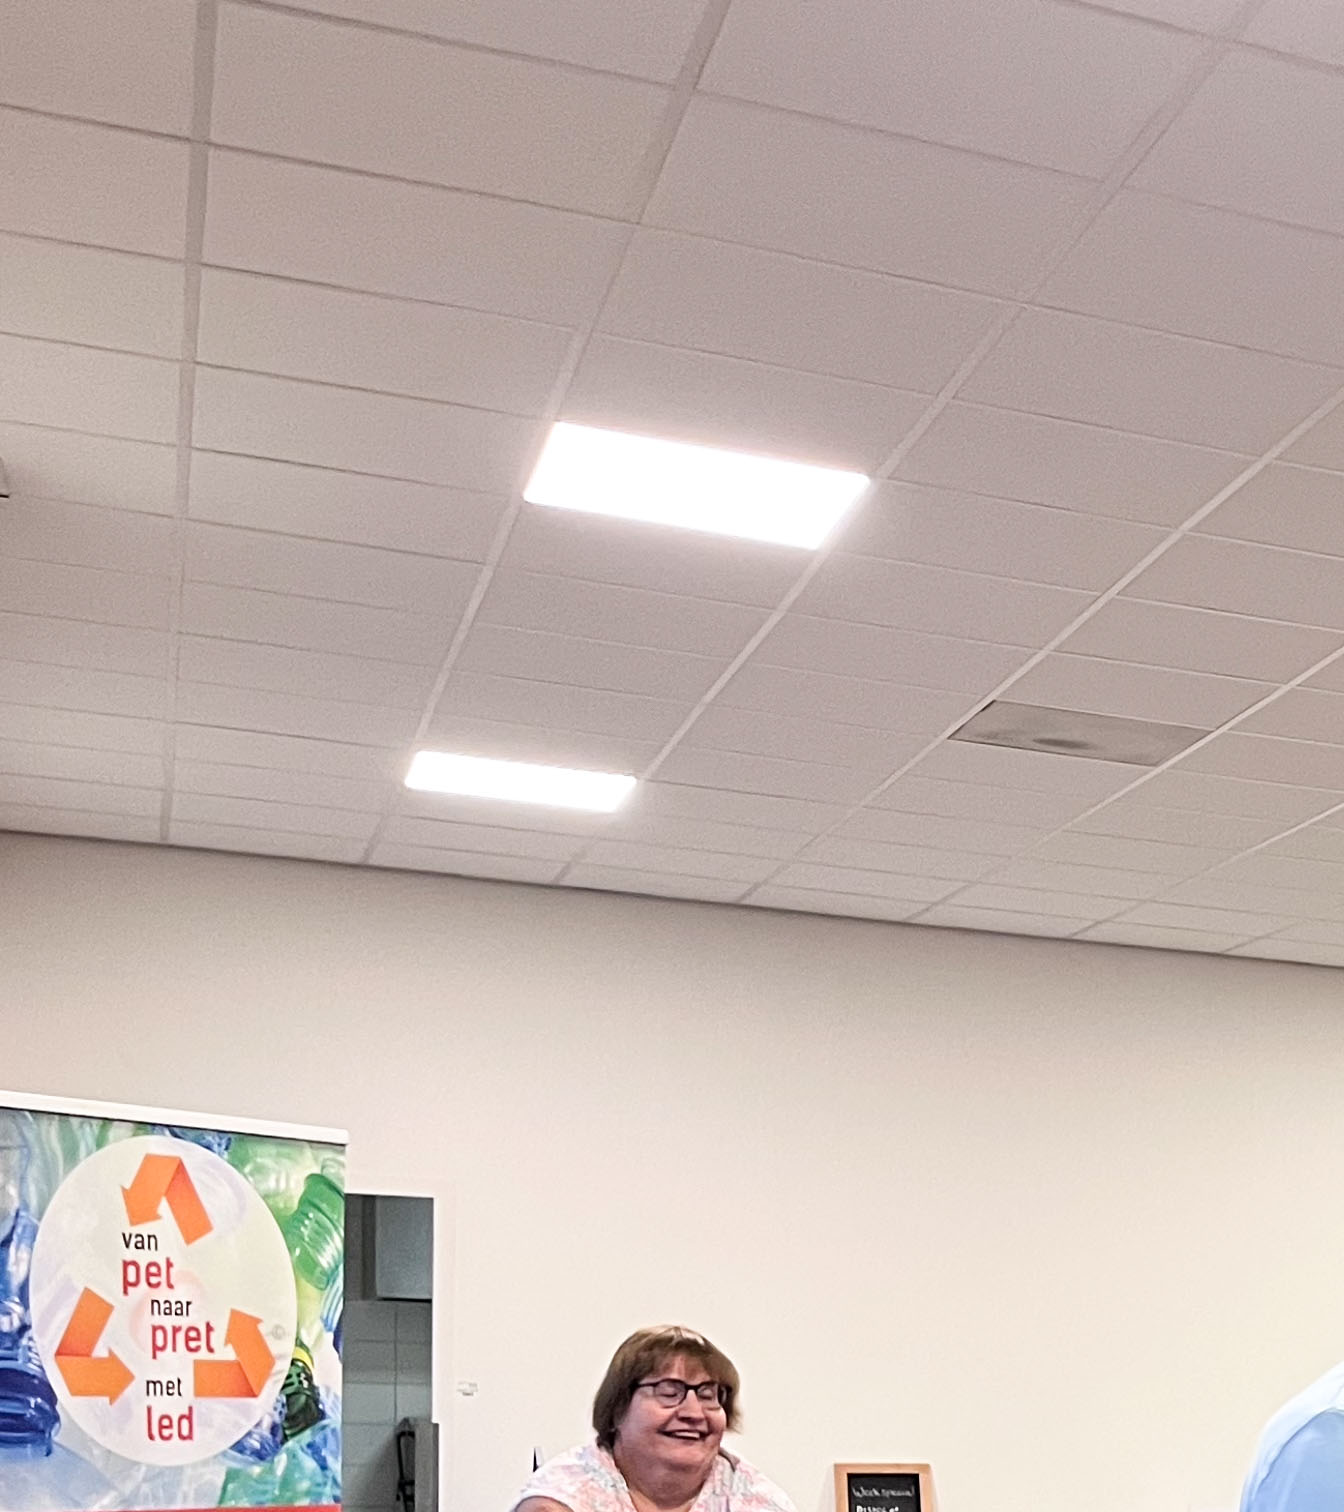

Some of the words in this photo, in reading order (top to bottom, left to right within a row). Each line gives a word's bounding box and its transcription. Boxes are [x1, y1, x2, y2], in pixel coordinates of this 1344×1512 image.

[122, 1232, 158, 1251] van
[121, 1257, 174, 1296] pet
[150, 1297, 192, 1316] naar
[151, 1321, 216, 1359] pret
[146, 1378, 182, 1397] met
[146, 1406, 194, 1441] led
